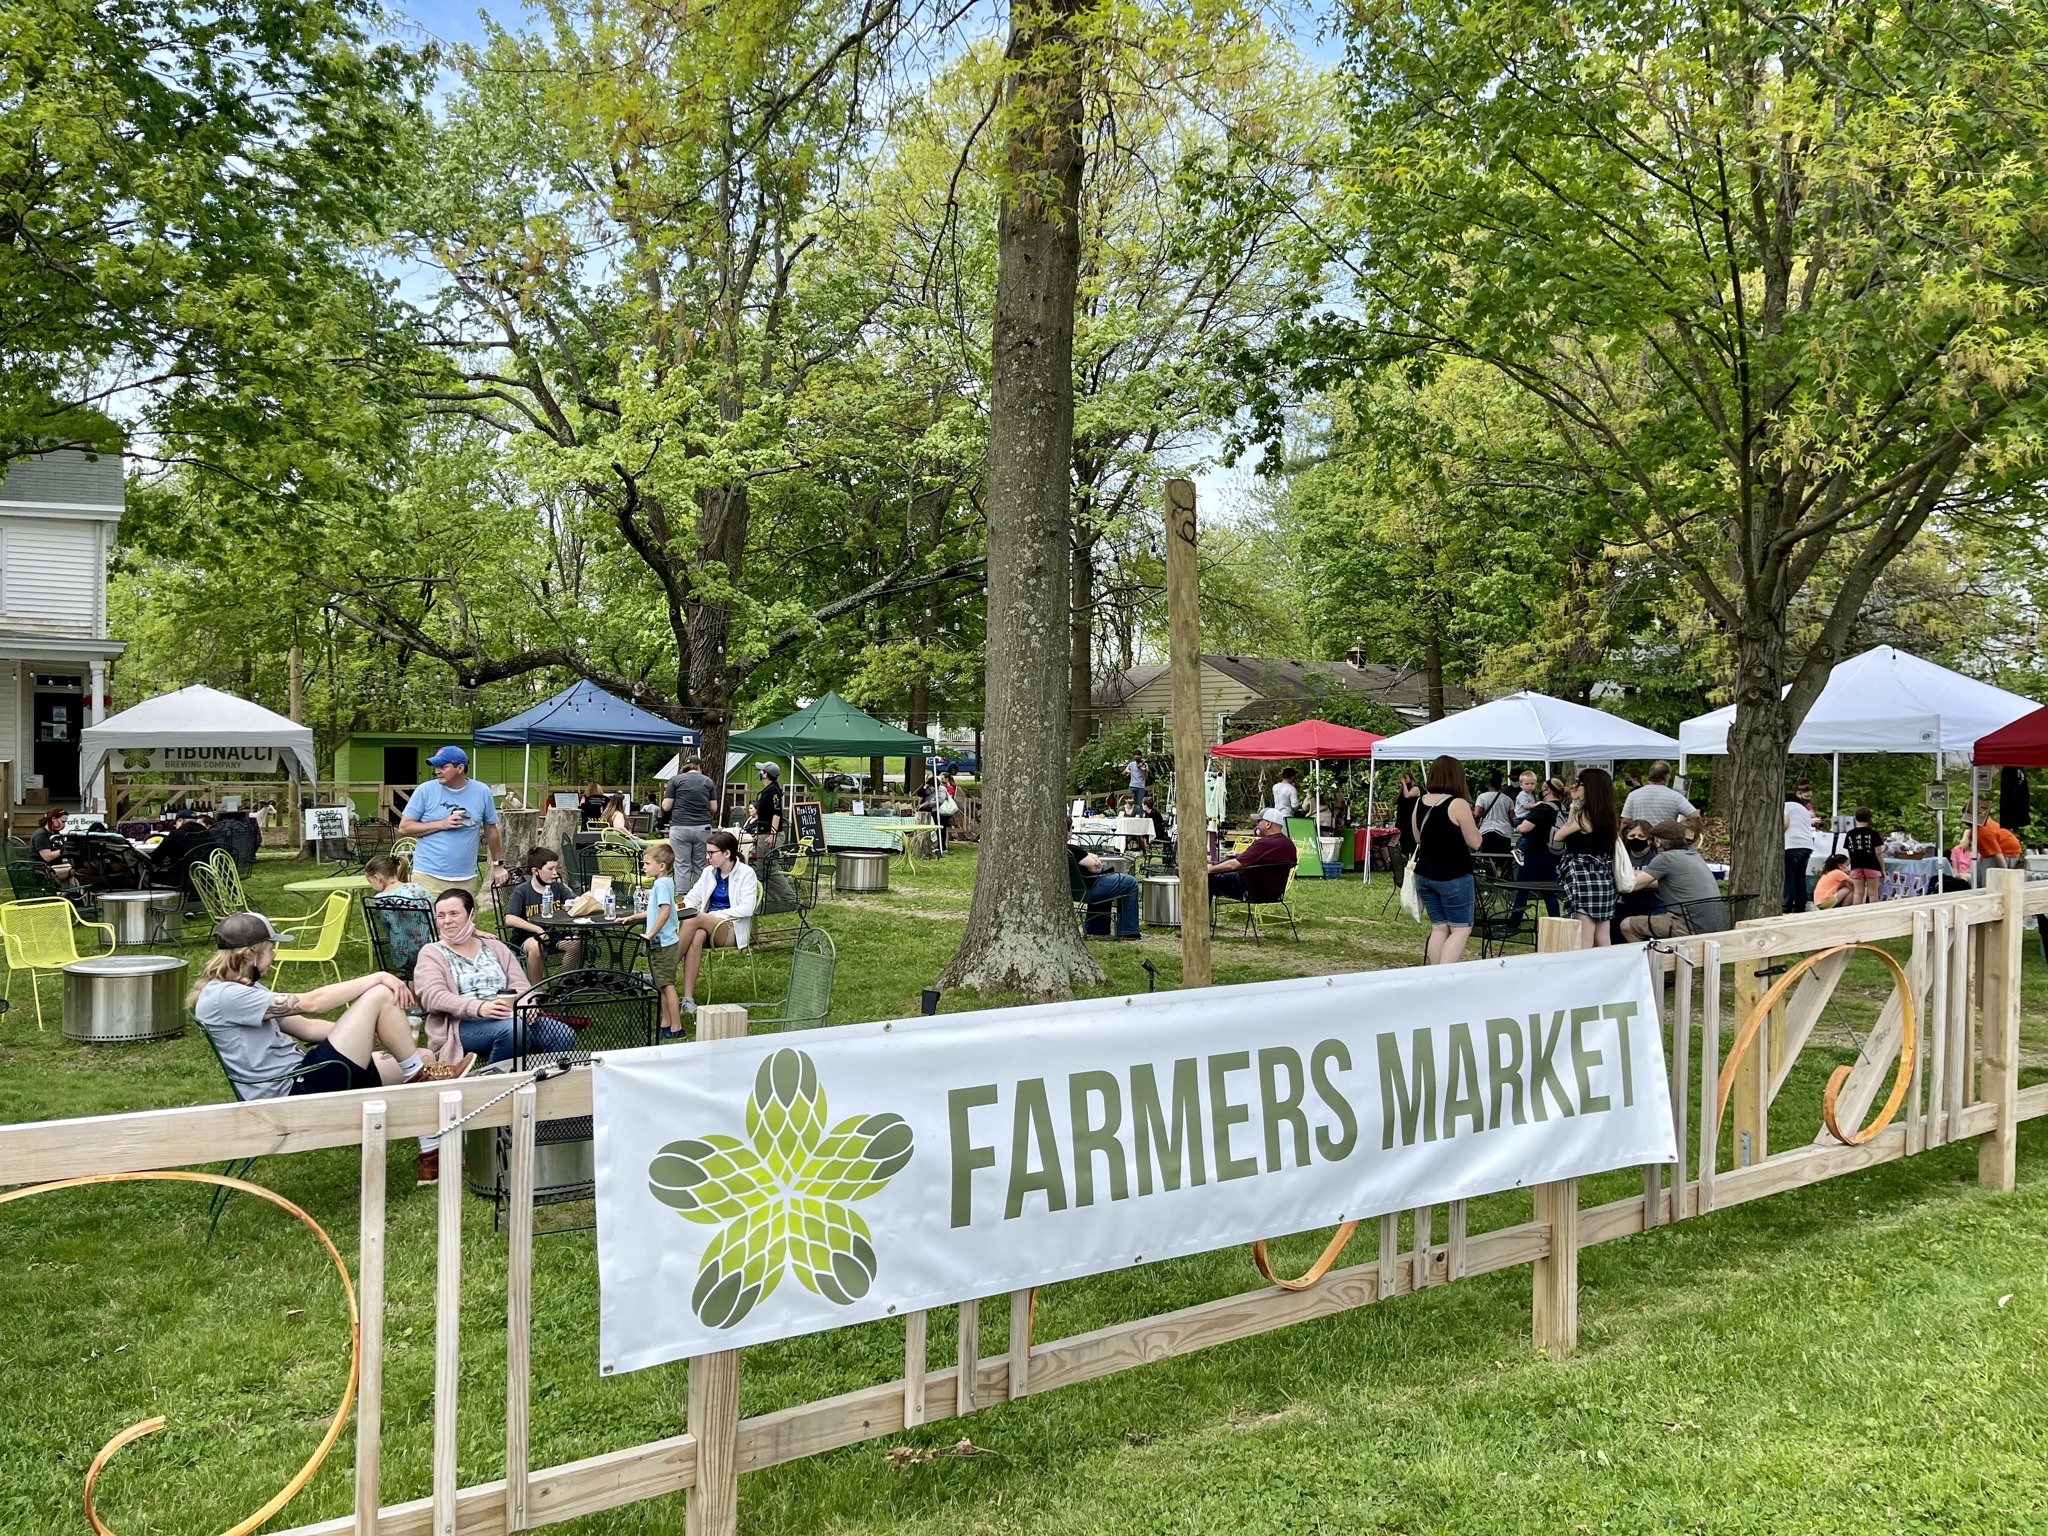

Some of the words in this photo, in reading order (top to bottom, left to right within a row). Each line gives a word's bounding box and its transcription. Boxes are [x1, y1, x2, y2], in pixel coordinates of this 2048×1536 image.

[165, 760, 202, 768] BREWING
[203, 761, 241, 769] COMPANY
[796, 806, 817, 816] Healthy
[802, 815, 816, 826] Hills
[947, 1038, 1359, 1230] FARMERS
[1377, 1001, 1640, 1151] MARKET
